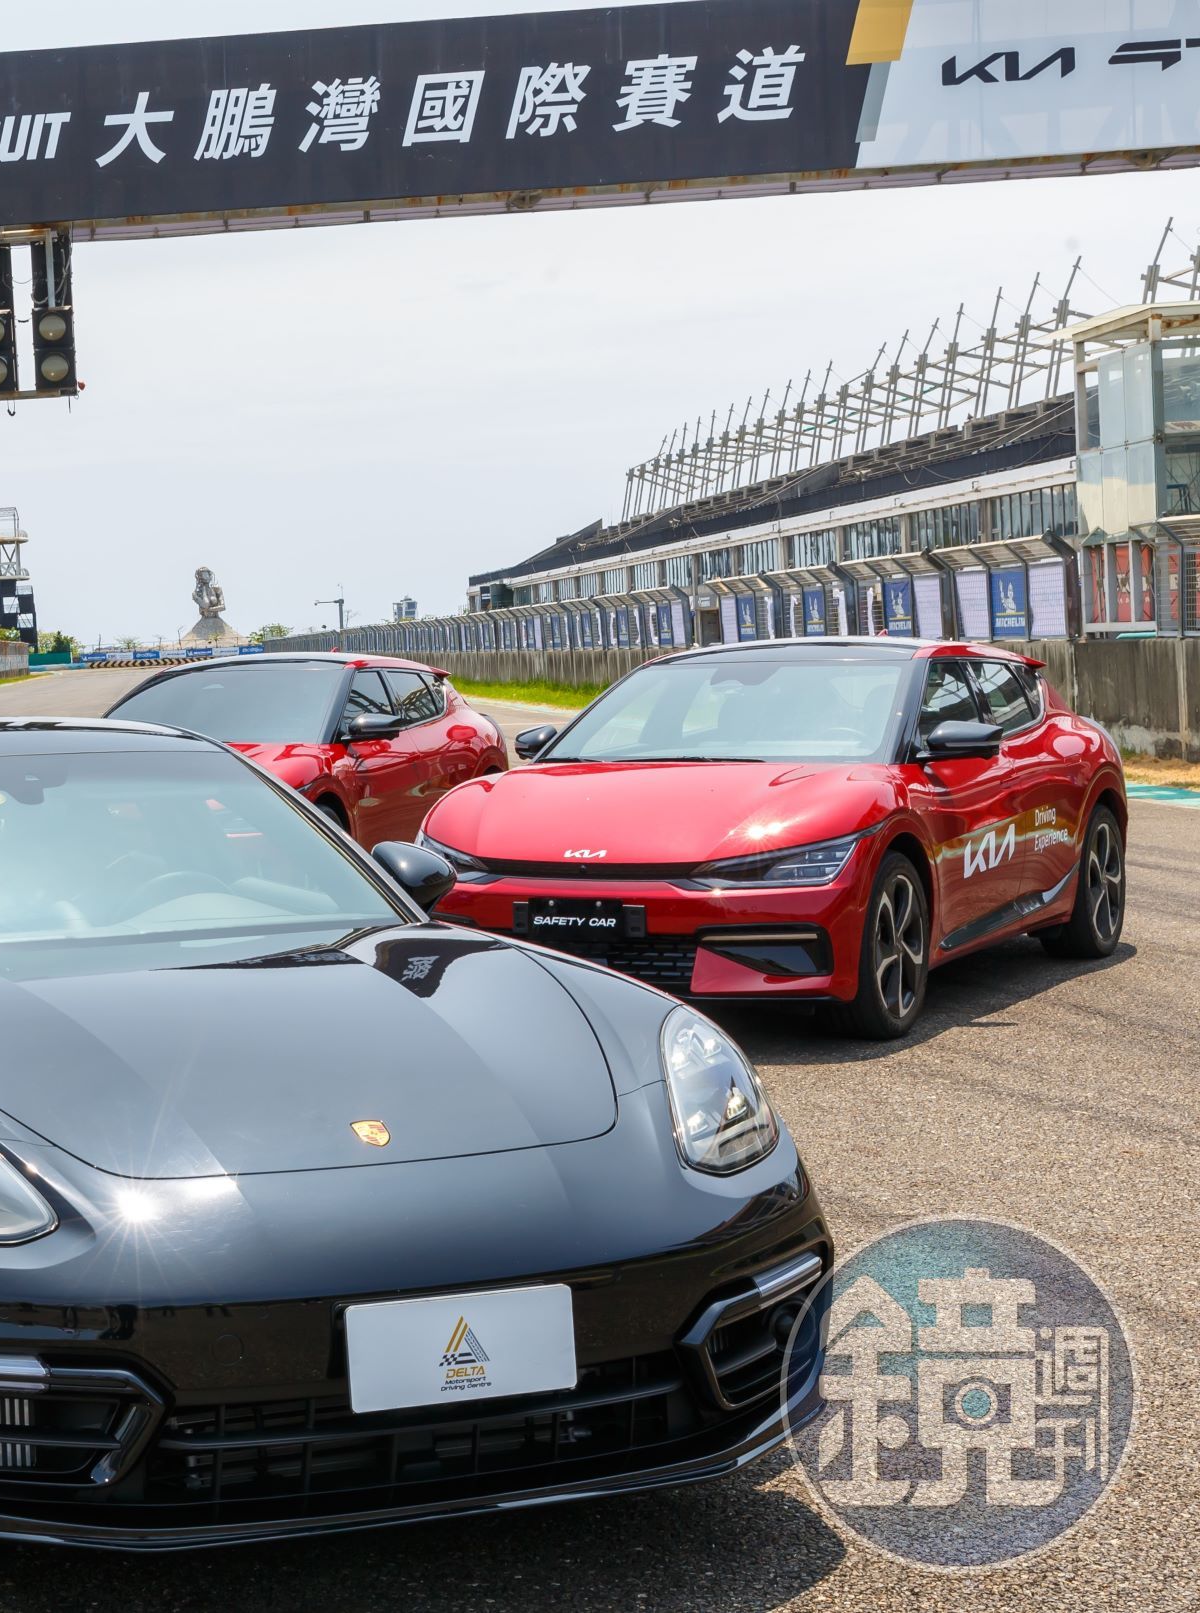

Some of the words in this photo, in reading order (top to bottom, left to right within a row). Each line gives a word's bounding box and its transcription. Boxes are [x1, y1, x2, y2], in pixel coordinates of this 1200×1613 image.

[942, 47, 1075, 86] KIA
[96, 44, 805, 167] 大鵬灣國際賽道
[994, 615, 1026, 628] MICHELIN
[1034, 807, 1056, 826] Driving
[1034, 828, 1069, 853] Experience
[563, 849, 607, 859] KIA
[963, 823, 1016, 879] KIA
[533, 916, 586, 927] SAFETY
[588, 917, 617, 928] CAR
[446, 1366, 485, 1378] DELTA
[445, 1376, 487, 1385] Motorsport
